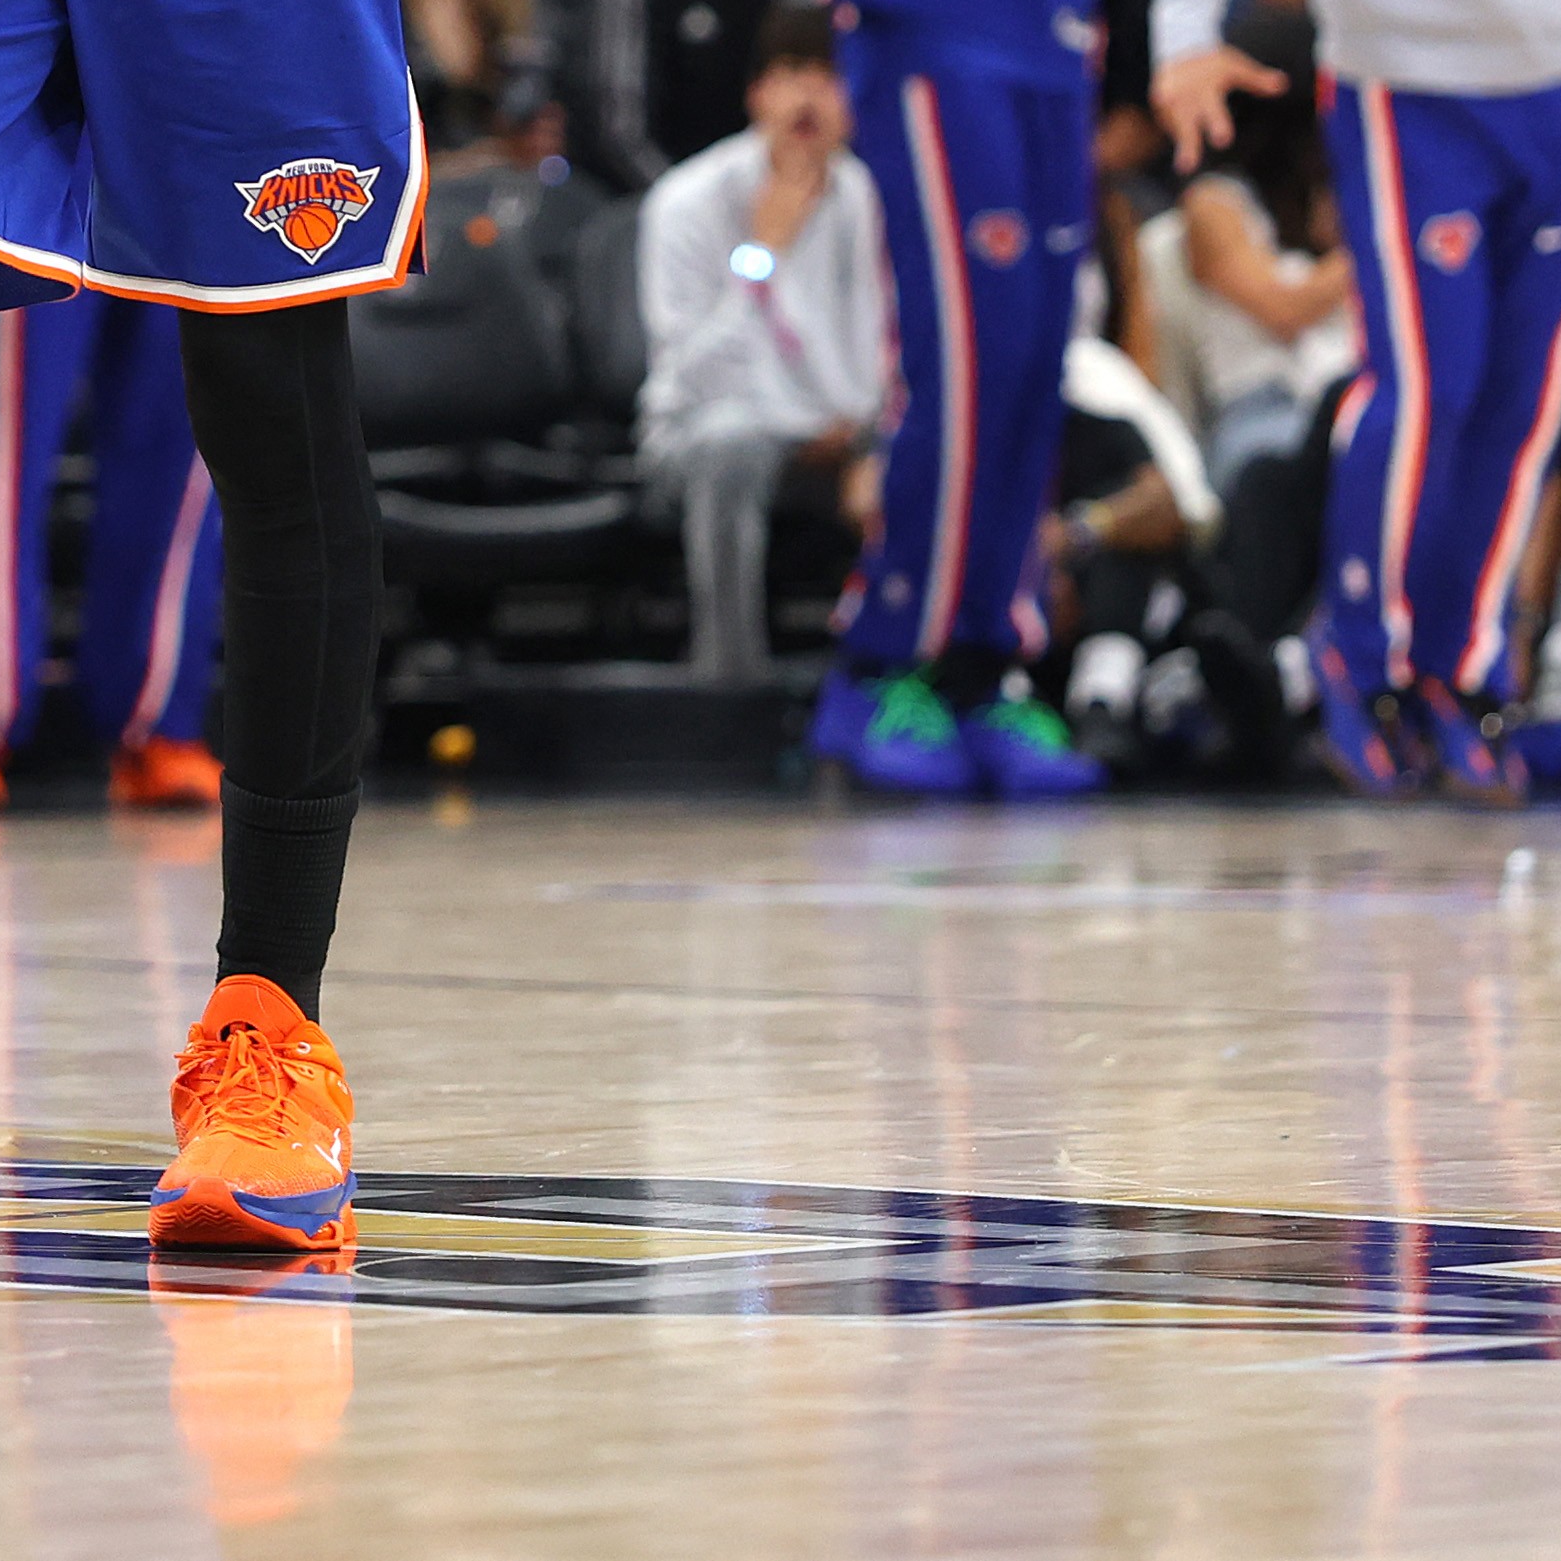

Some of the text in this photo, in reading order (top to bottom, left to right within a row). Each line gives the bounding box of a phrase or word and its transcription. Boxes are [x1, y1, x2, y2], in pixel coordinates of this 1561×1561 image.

[285, 162, 334, 177] NEW YORK
[250, 168, 369, 217] KNICKS
